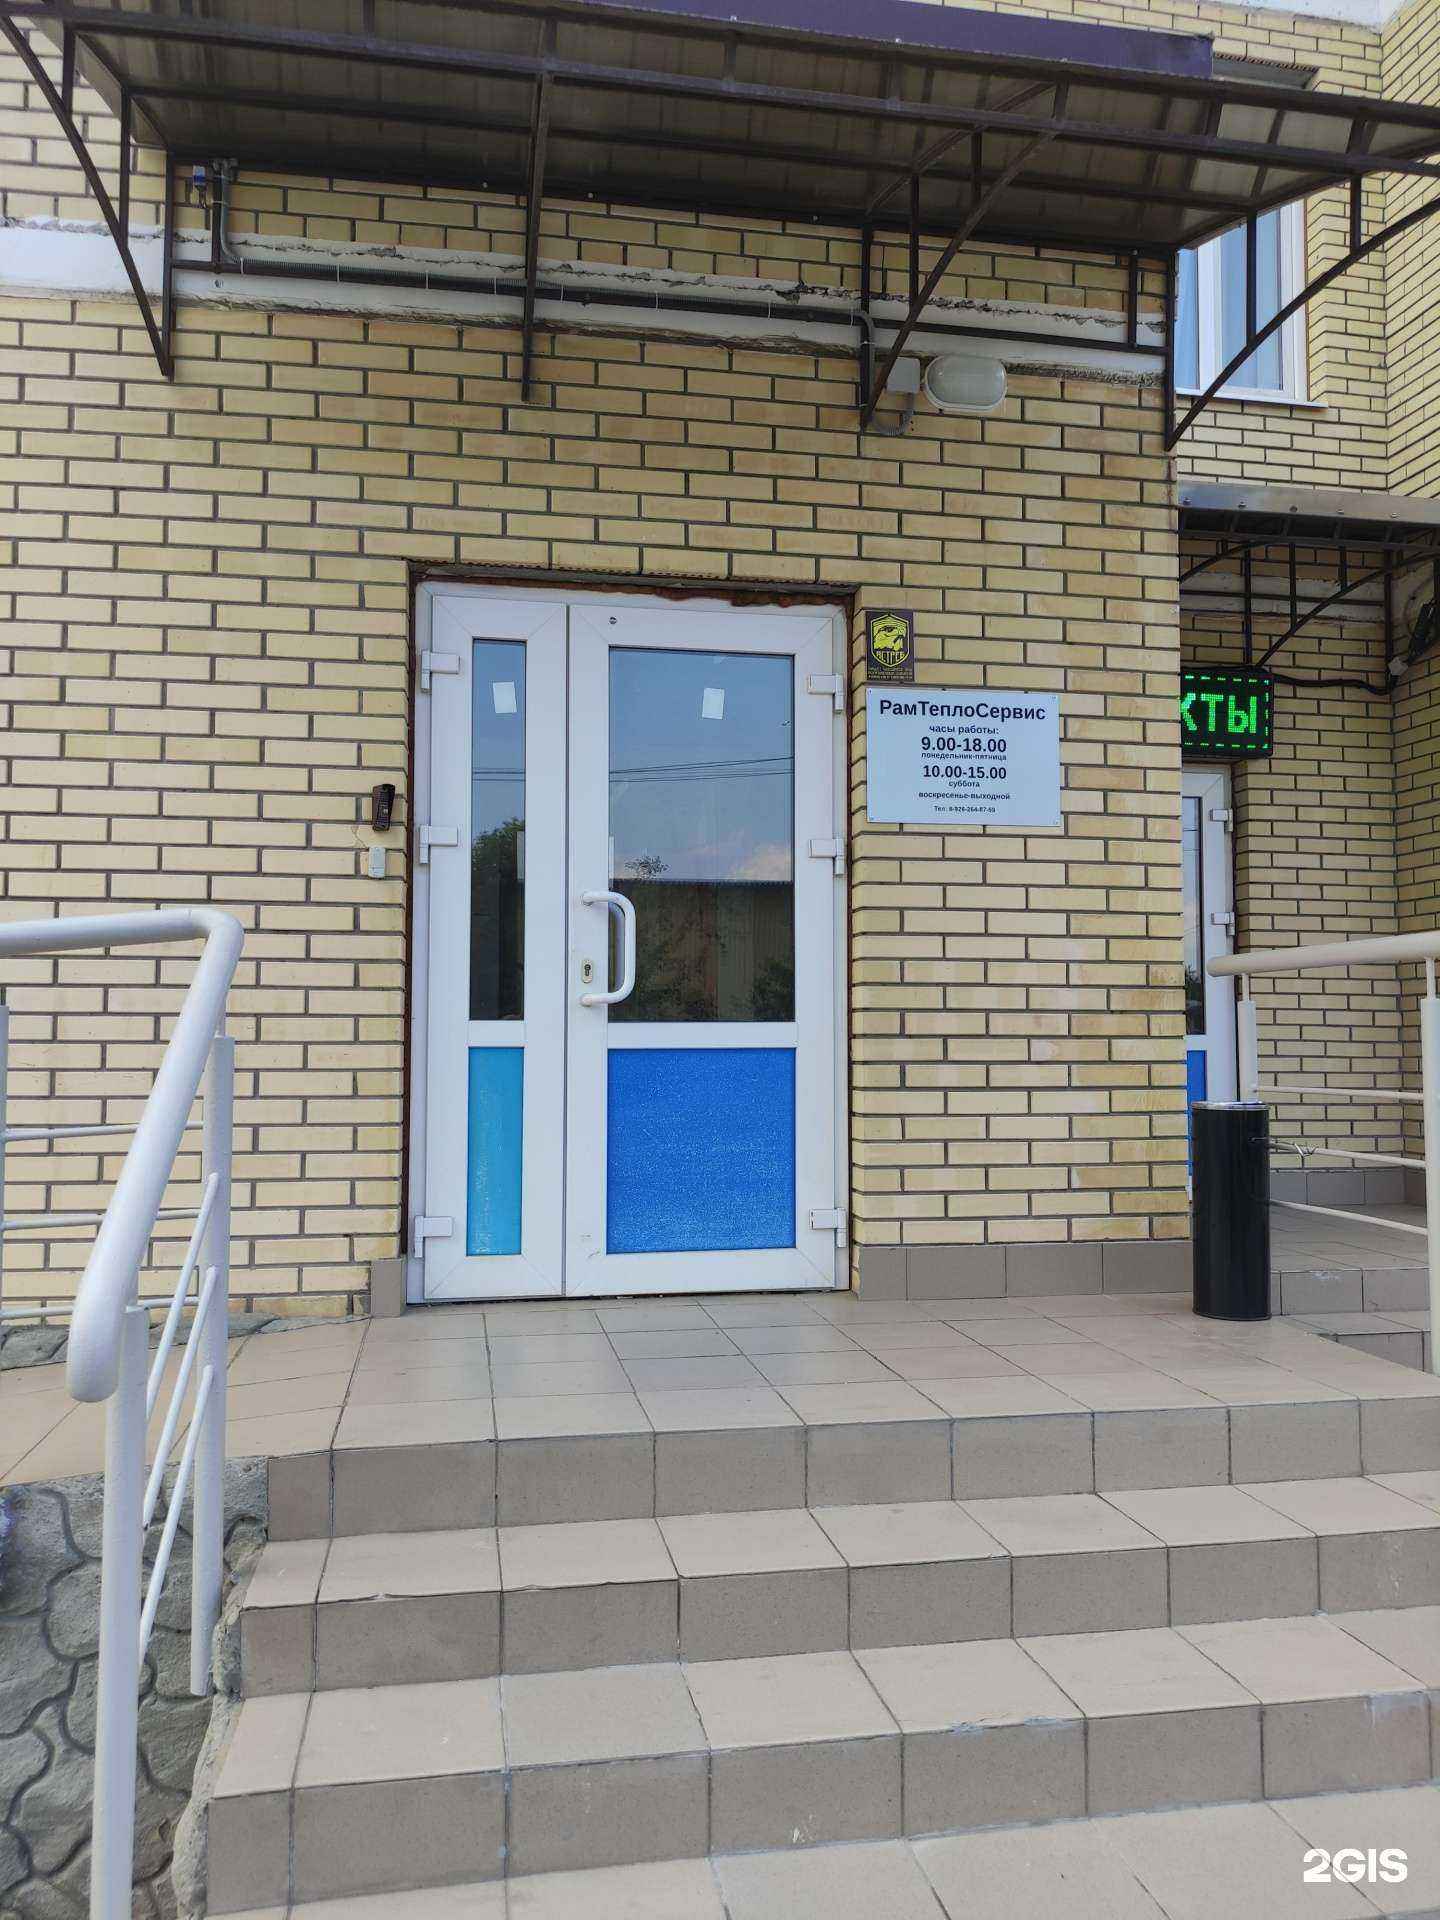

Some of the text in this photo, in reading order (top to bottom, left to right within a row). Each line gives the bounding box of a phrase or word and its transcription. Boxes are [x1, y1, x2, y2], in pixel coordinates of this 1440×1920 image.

[879, 700, 1046, 722] РамТеплоСервис
[958, 725, 1000, 735] работы:
[921, 736, 1007, 752] 9.00-18.00
[921, 752, 1007, 761] понедельник-пятница
[923, 765, 1007, 779] 10.00-15.00
[918, 791, 1011, 800] воскресенье-выходной
